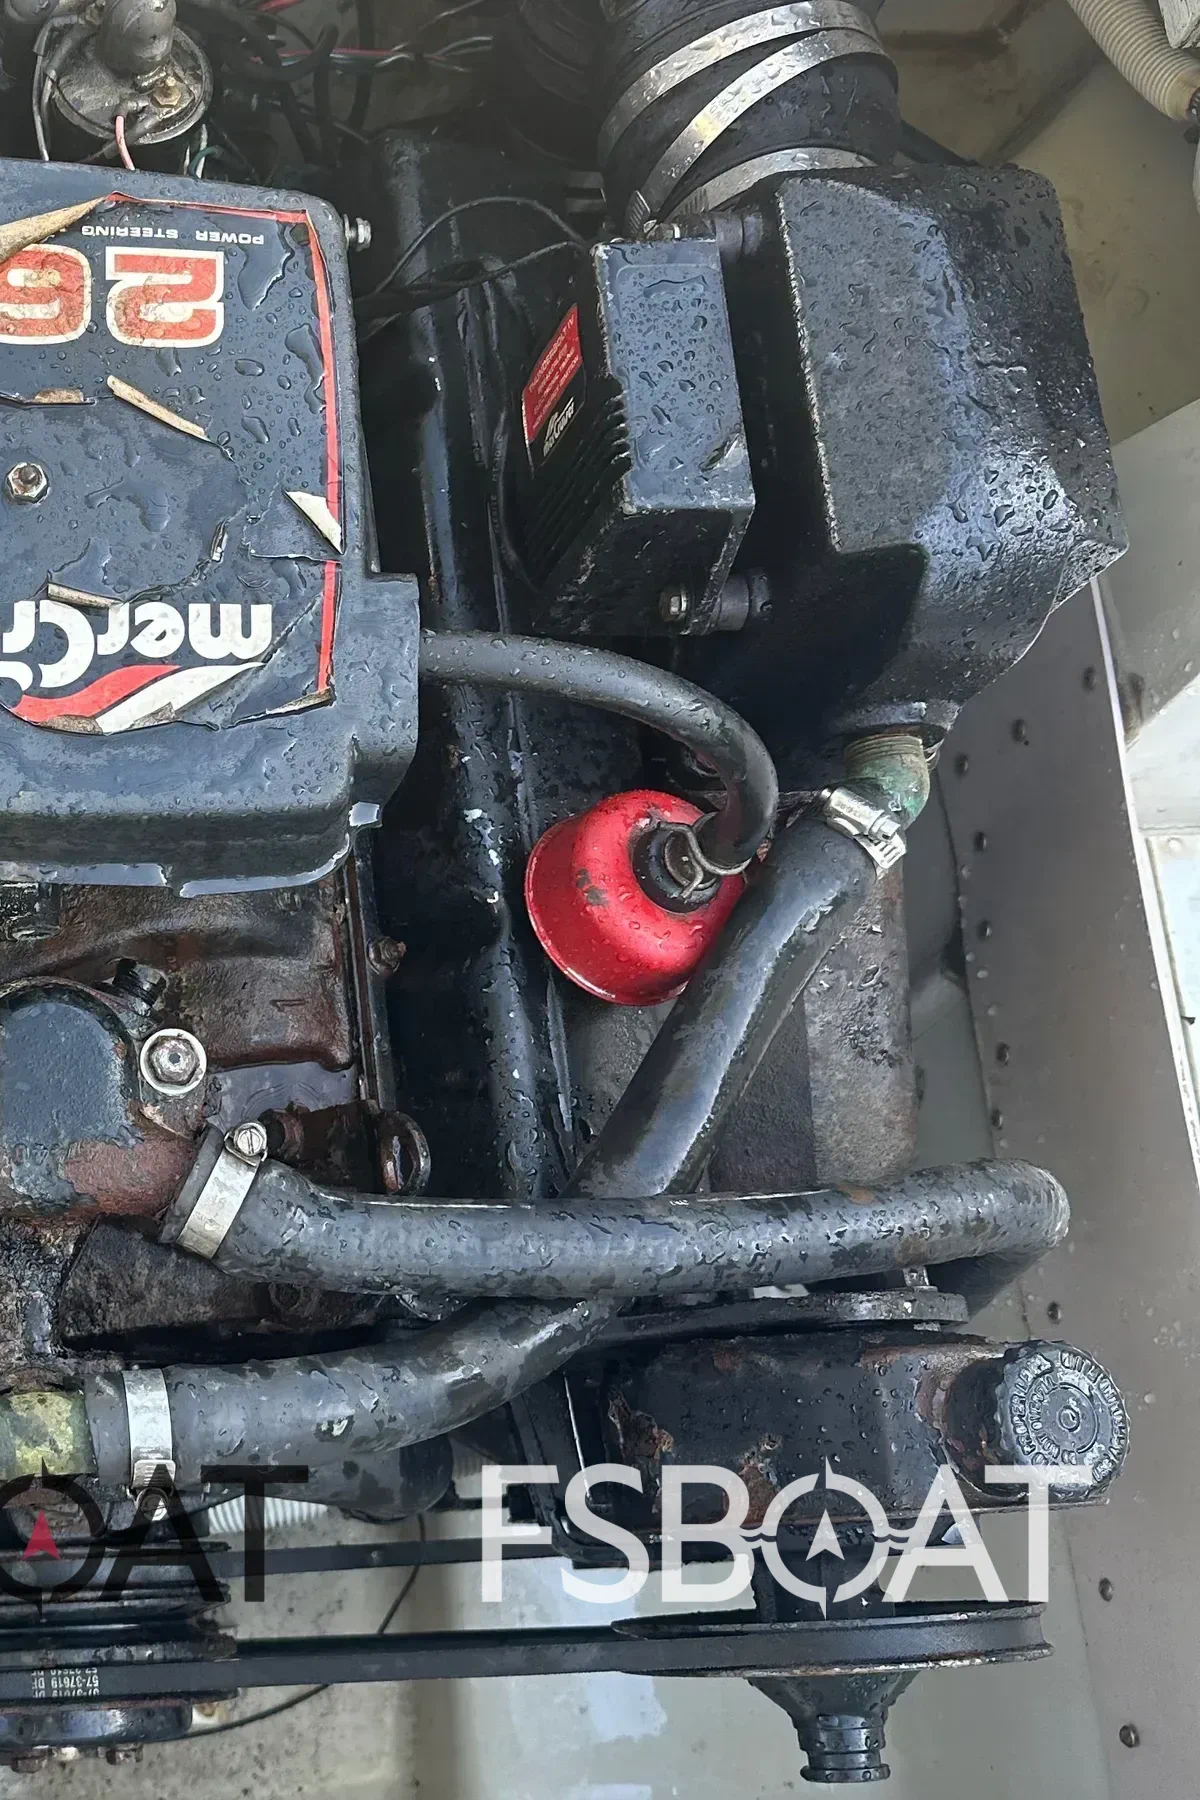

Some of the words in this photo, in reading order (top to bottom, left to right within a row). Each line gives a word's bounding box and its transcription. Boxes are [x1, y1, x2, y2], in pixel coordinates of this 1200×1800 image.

[81, 225, 179, 240] STEERING
[194, 230, 264, 245] POWER
[51, 1674, 99, 1689] 57-37619
